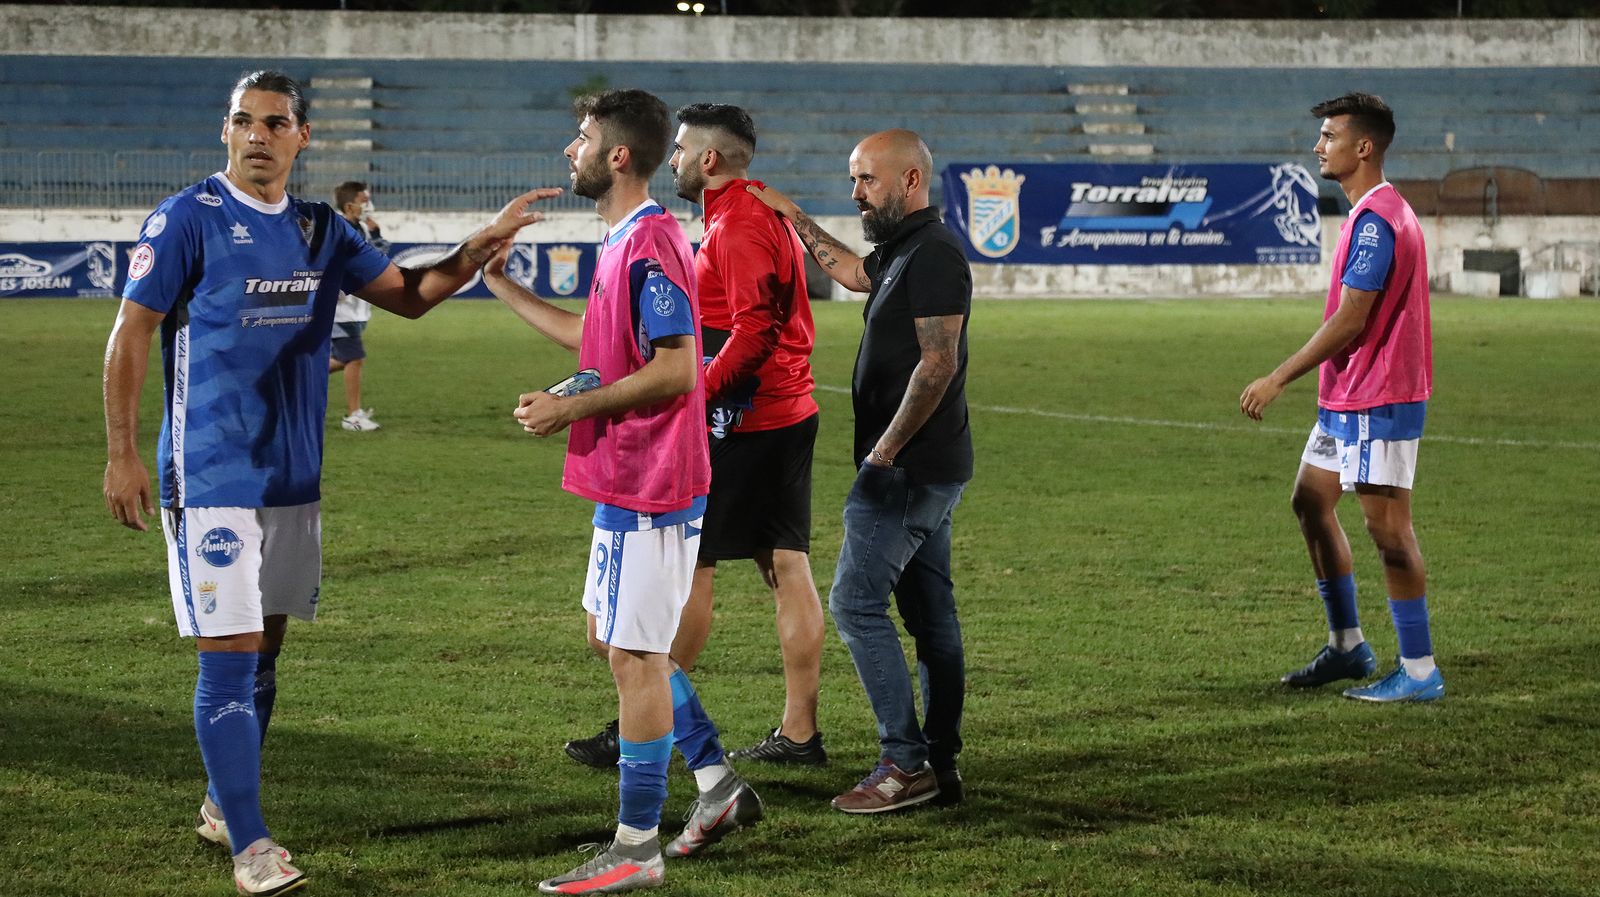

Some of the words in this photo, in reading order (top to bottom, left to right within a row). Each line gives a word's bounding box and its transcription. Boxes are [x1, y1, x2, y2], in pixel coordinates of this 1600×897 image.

[1070, 181, 1208, 204] Torralva
[1040, 225, 1058, 247] Te
[20, 276, 72, 290] JOSEAN
[244, 278, 321, 294] Torralv
[175, 368, 186, 407] XEREZ
[197, 539, 244, 556] Amigos
[609, 558, 618, 600] XEREZ
